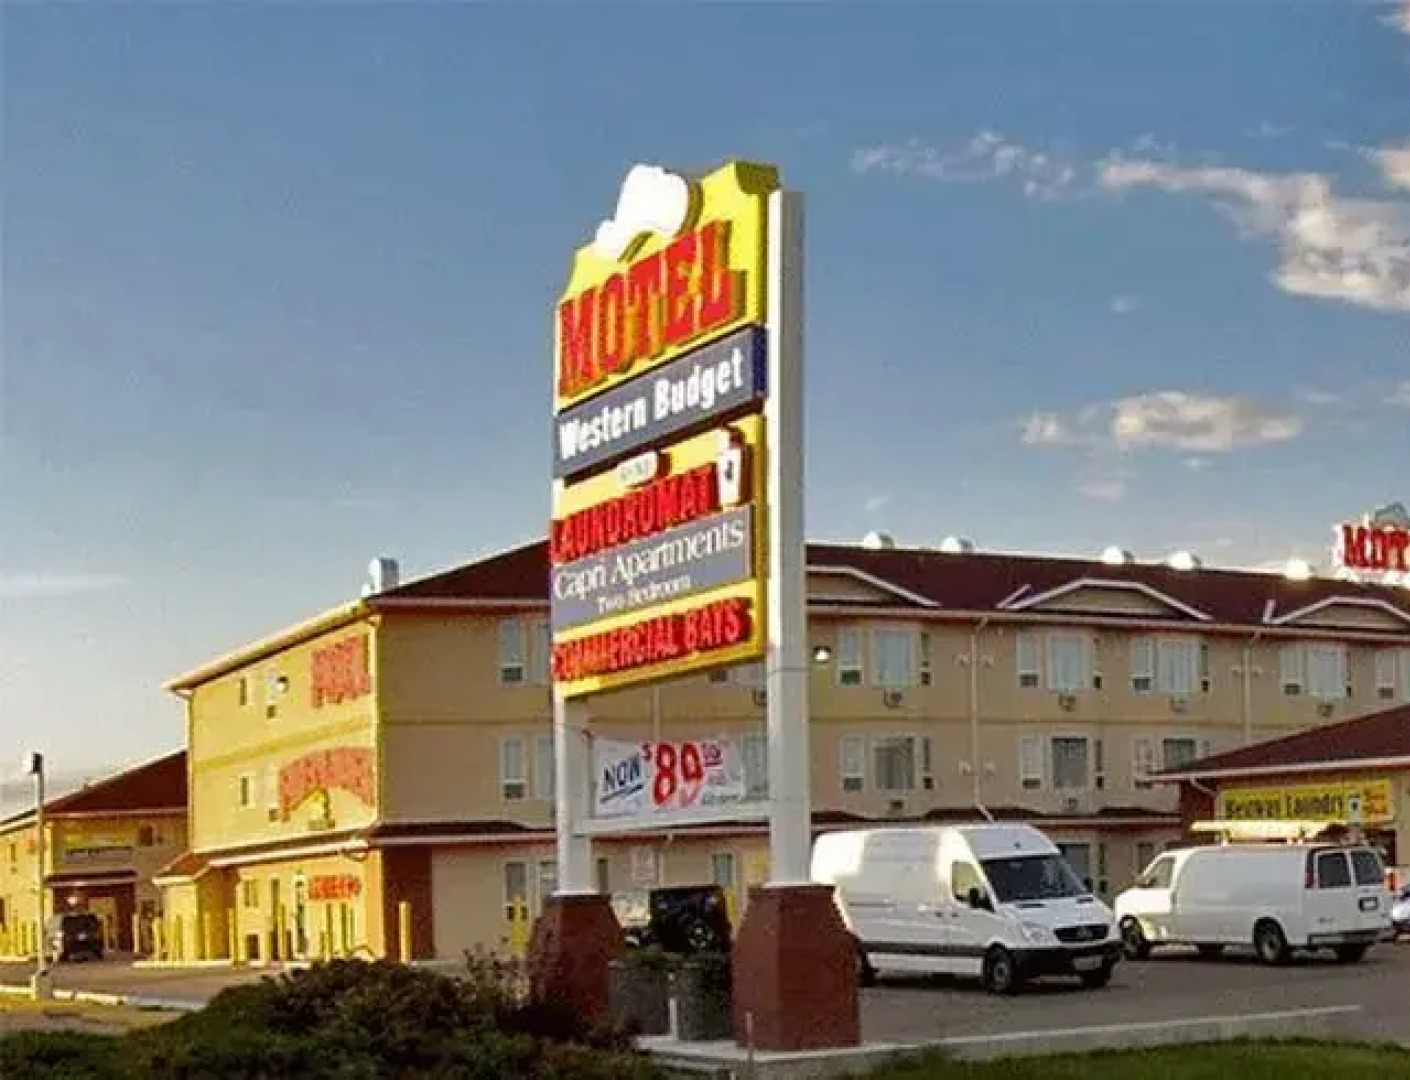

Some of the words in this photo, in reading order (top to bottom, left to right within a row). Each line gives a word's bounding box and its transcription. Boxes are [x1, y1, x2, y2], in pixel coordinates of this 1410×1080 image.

[558, 219, 742, 397] MOTEL
[559, 397, 648, 461] Western
[654, 347, 744, 421] Budget
[550, 461, 718, 565] LAUNDROMAT
[611, 519, 745, 585] Apartments
[551, 613, 681, 681] COMMERCIAL
[683, 597, 743, 651] BAYS
[603, 756, 641, 792] NOW
